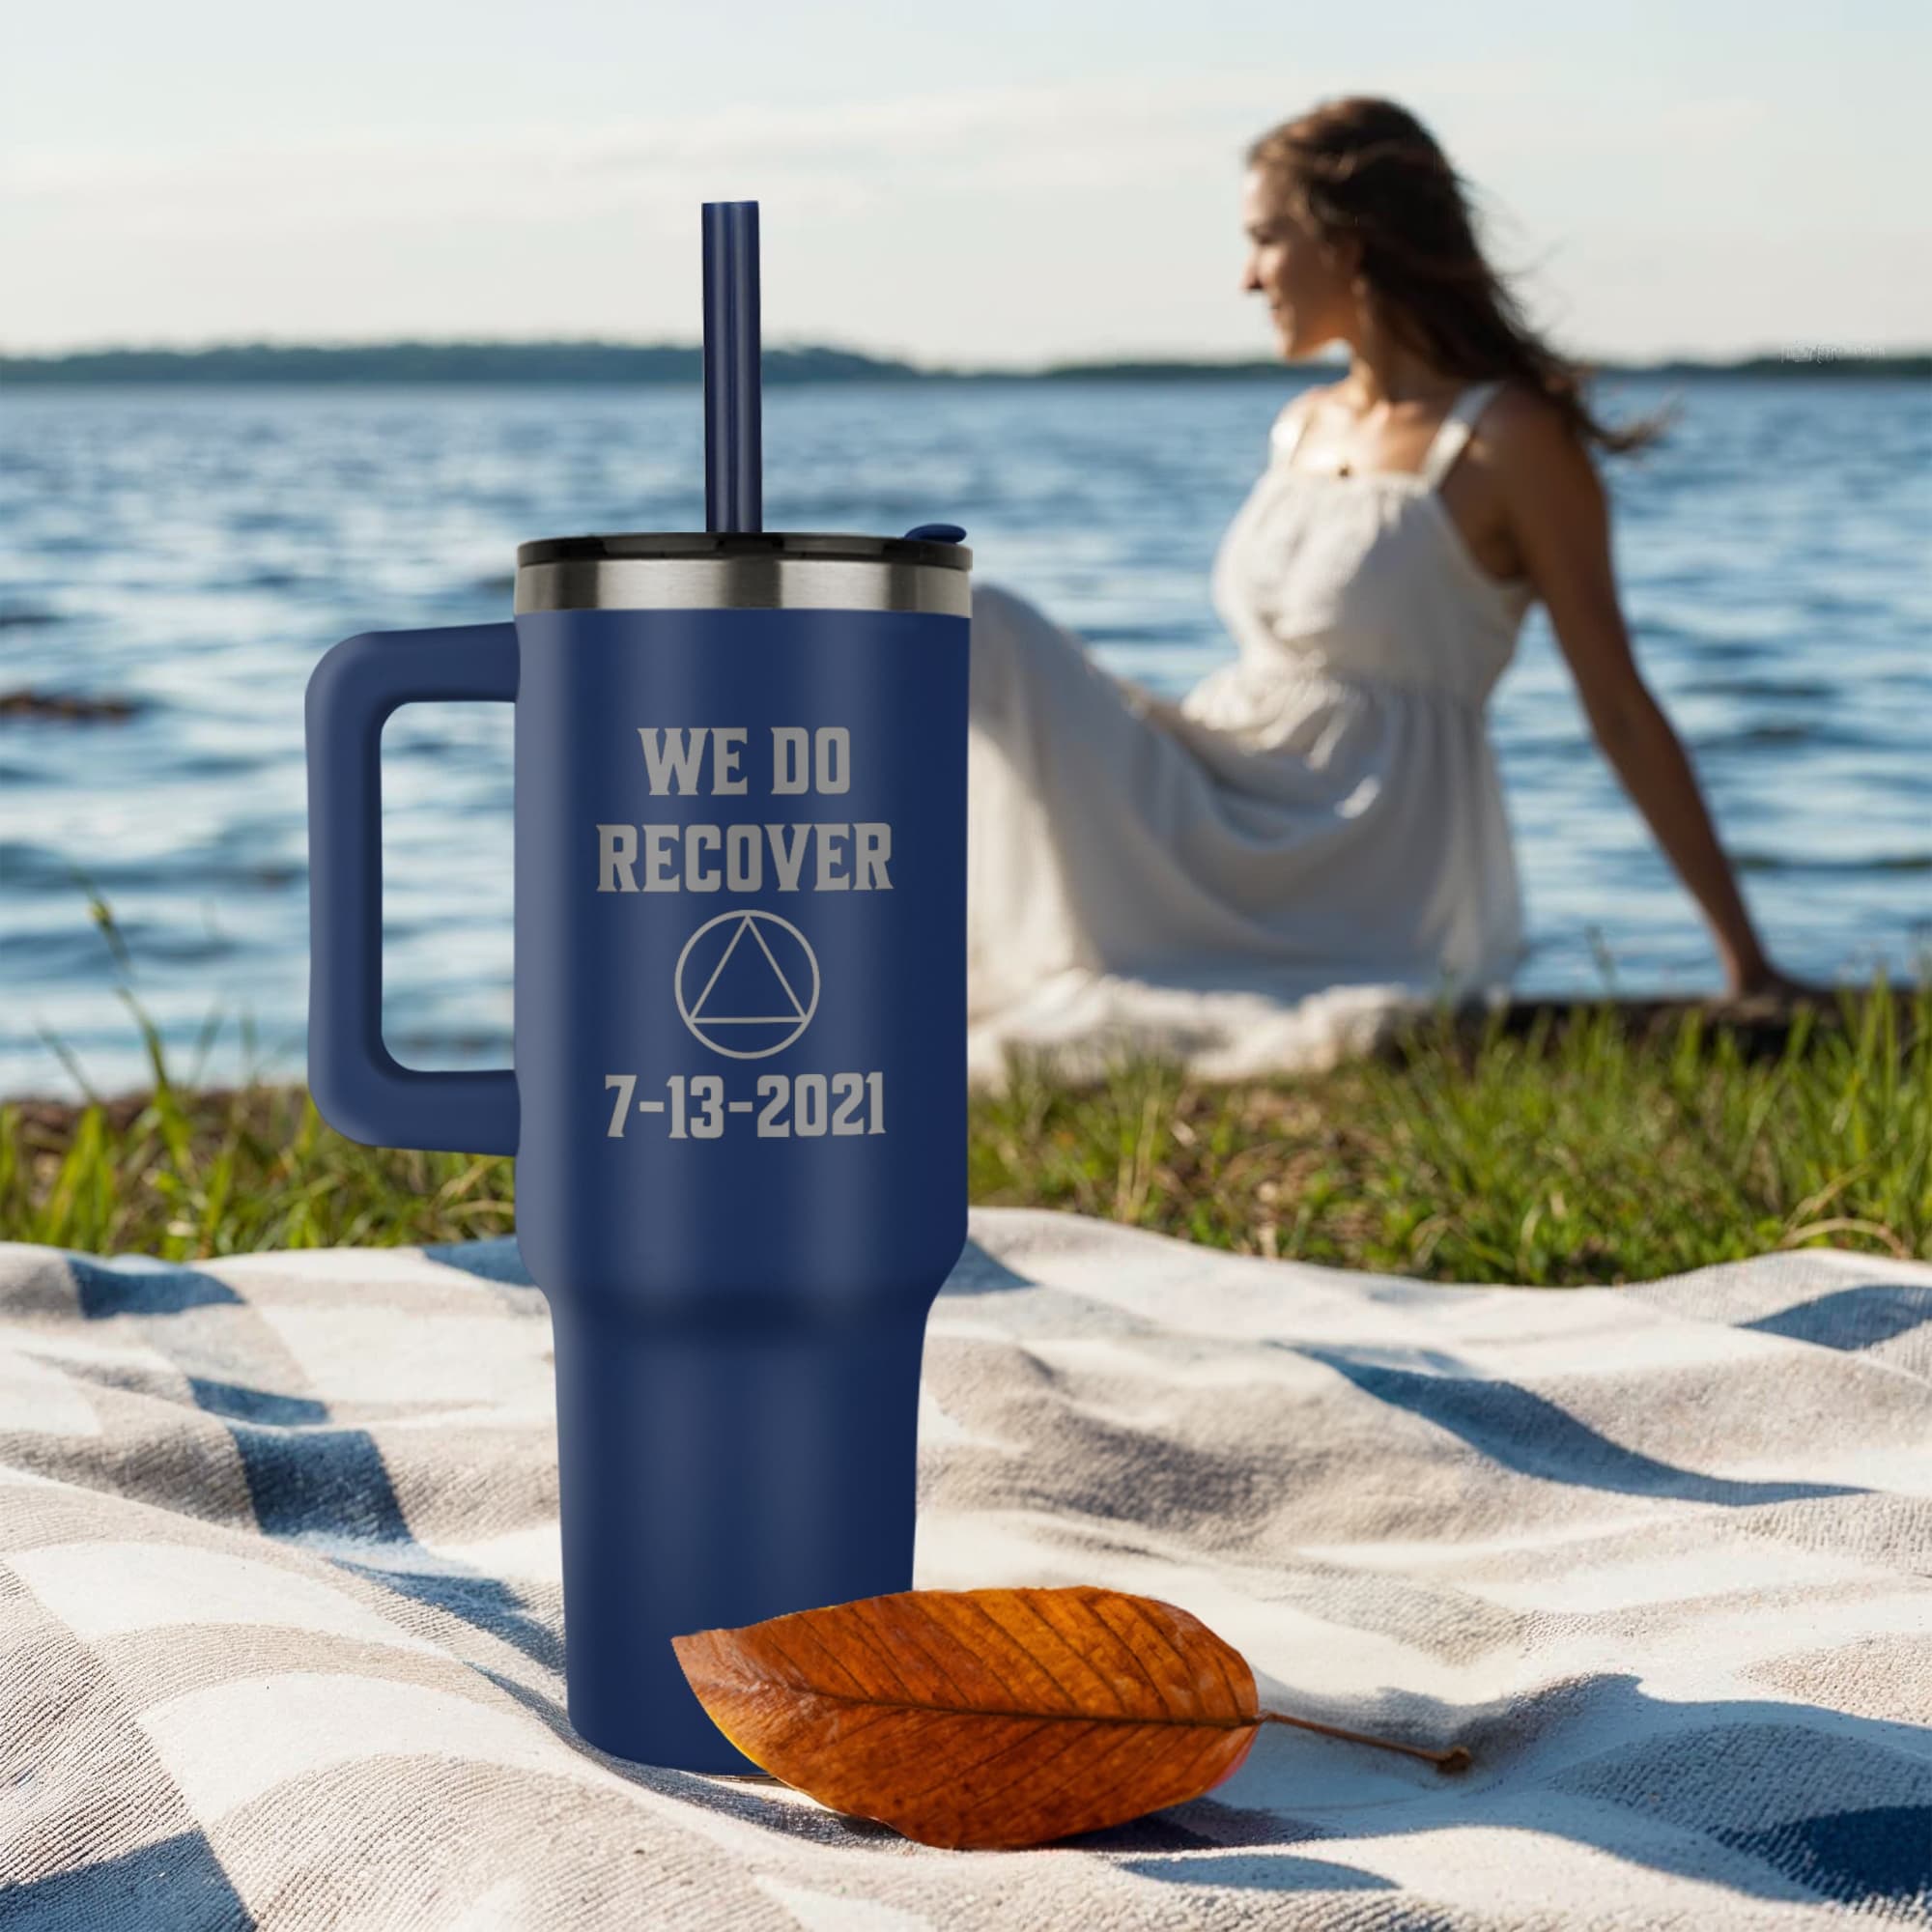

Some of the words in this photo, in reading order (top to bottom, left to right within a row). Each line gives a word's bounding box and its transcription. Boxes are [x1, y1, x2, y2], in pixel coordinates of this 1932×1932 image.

[638, 726, 748, 797] WE
[770, 726, 851, 796] DO
[596, 822, 893, 893] RECOVER
[604, 1071, 887, 1139] 7-13-2021
